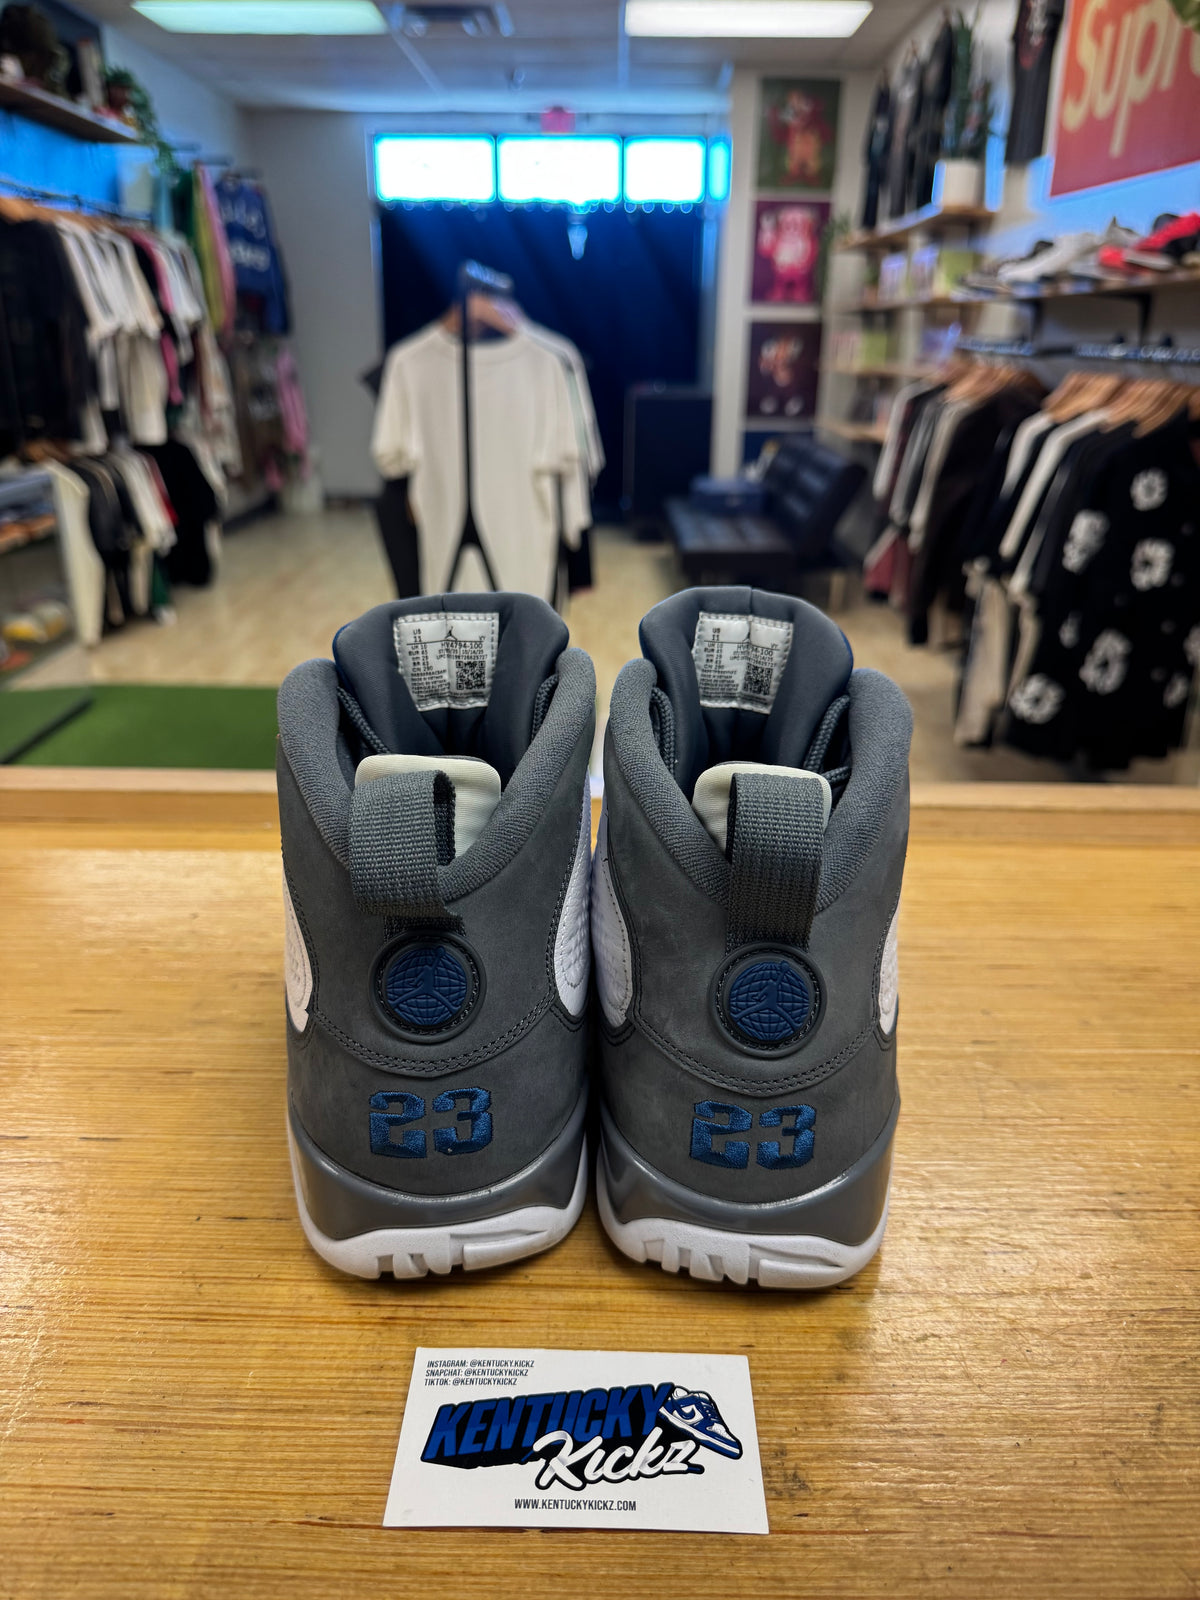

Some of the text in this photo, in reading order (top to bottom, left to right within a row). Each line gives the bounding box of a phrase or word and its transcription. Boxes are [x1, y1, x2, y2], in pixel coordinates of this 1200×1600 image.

[370, 1086, 492, 1158] 23
[690, 1100, 816, 1170] 23
[424, 1377, 518, 1386] TIKTOK: @KENTUCKYKICKZ
[425, 1368, 529, 1377] SNAPCHAT: @KENTUCKYKICKZ
[427, 1359, 535, 1368] INSTAGRAM: @KENTUCKY.KICKZ
[424, 1382, 675, 1461] KENTUCKY
[533, 1427, 702, 1489] Kickz
[514, 1498, 637, 1511] WWW.KENTUCKYKICKZ.COM
